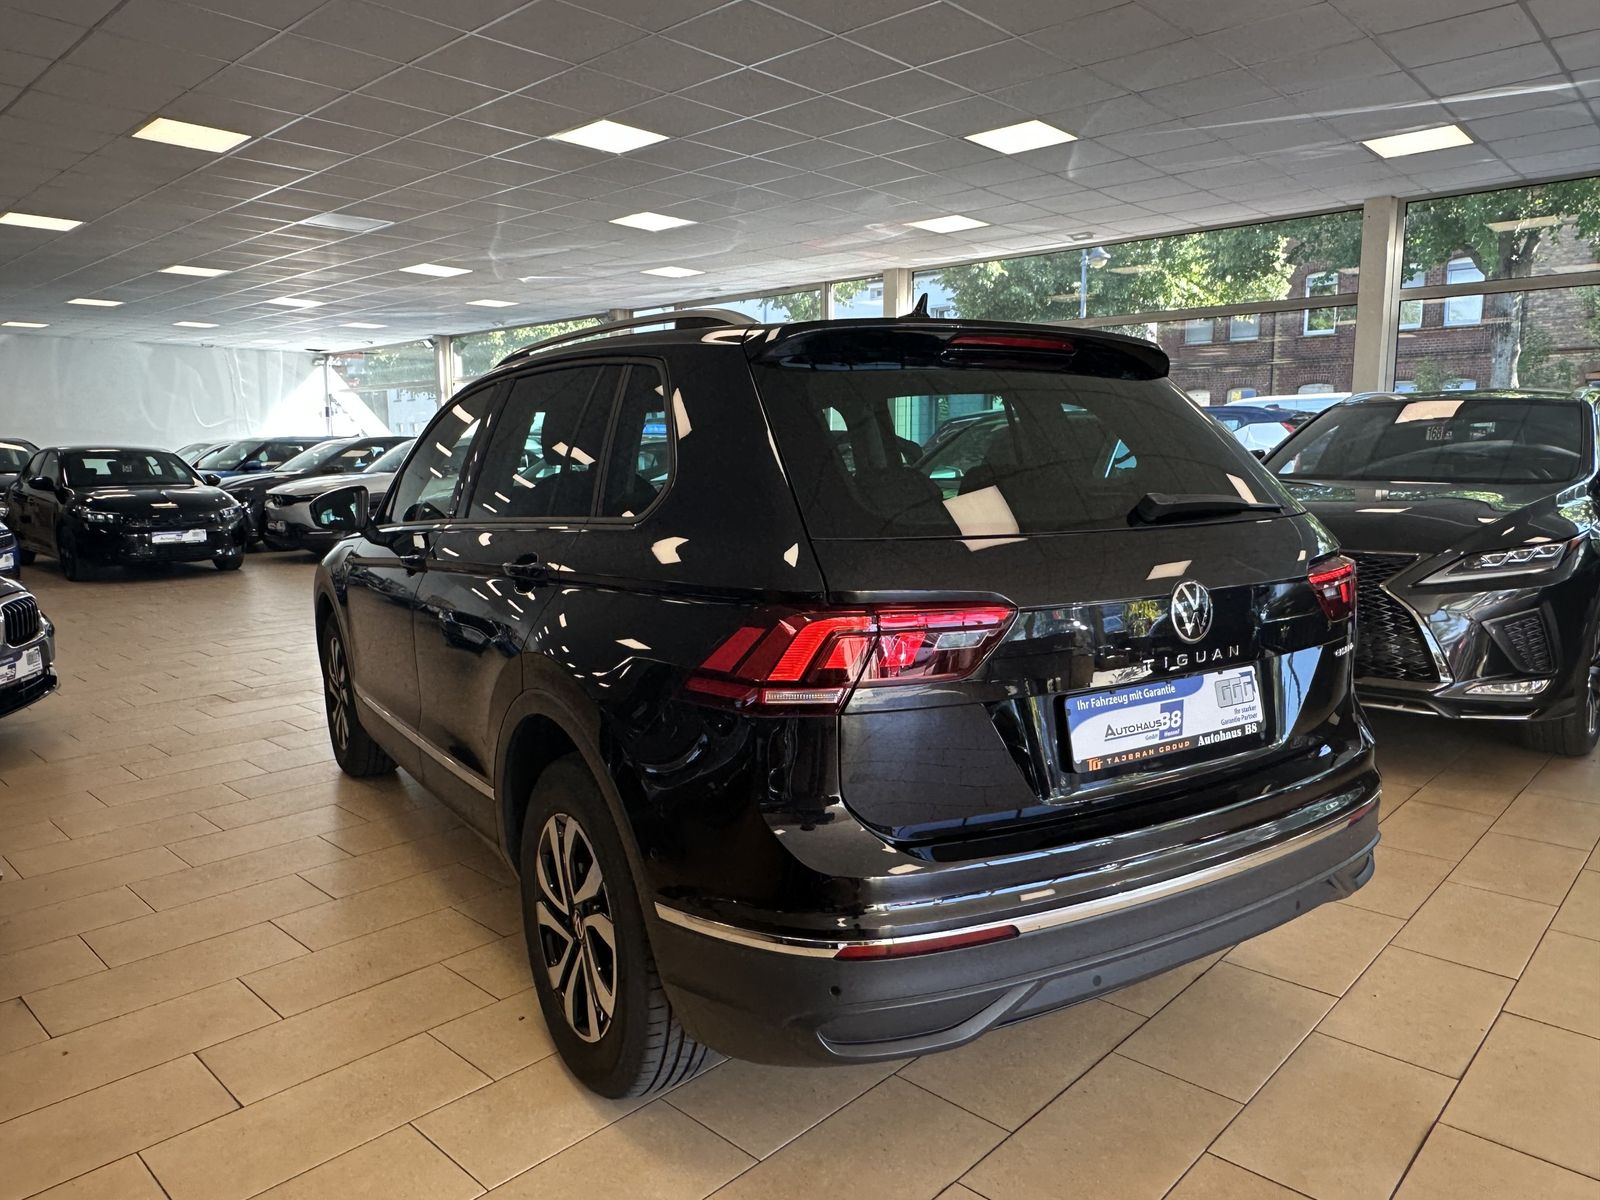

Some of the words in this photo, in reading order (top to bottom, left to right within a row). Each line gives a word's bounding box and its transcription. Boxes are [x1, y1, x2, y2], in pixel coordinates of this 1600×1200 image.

[1142, 644, 1239, 672] TIGUAN
[1077, 700, 1089, 711] Ihr
[1090, 694, 1128, 709] Fahrzeug
[1129, 689, 1142, 701] mit
[1143, 685, 1176, 698] Garantie
[1241, 711, 1258, 722] Partner
[1158, 740, 1190, 753] GROUP
[1198, 728, 1242, 747] Autohaus
[1245, 723, 1258, 736] B8
